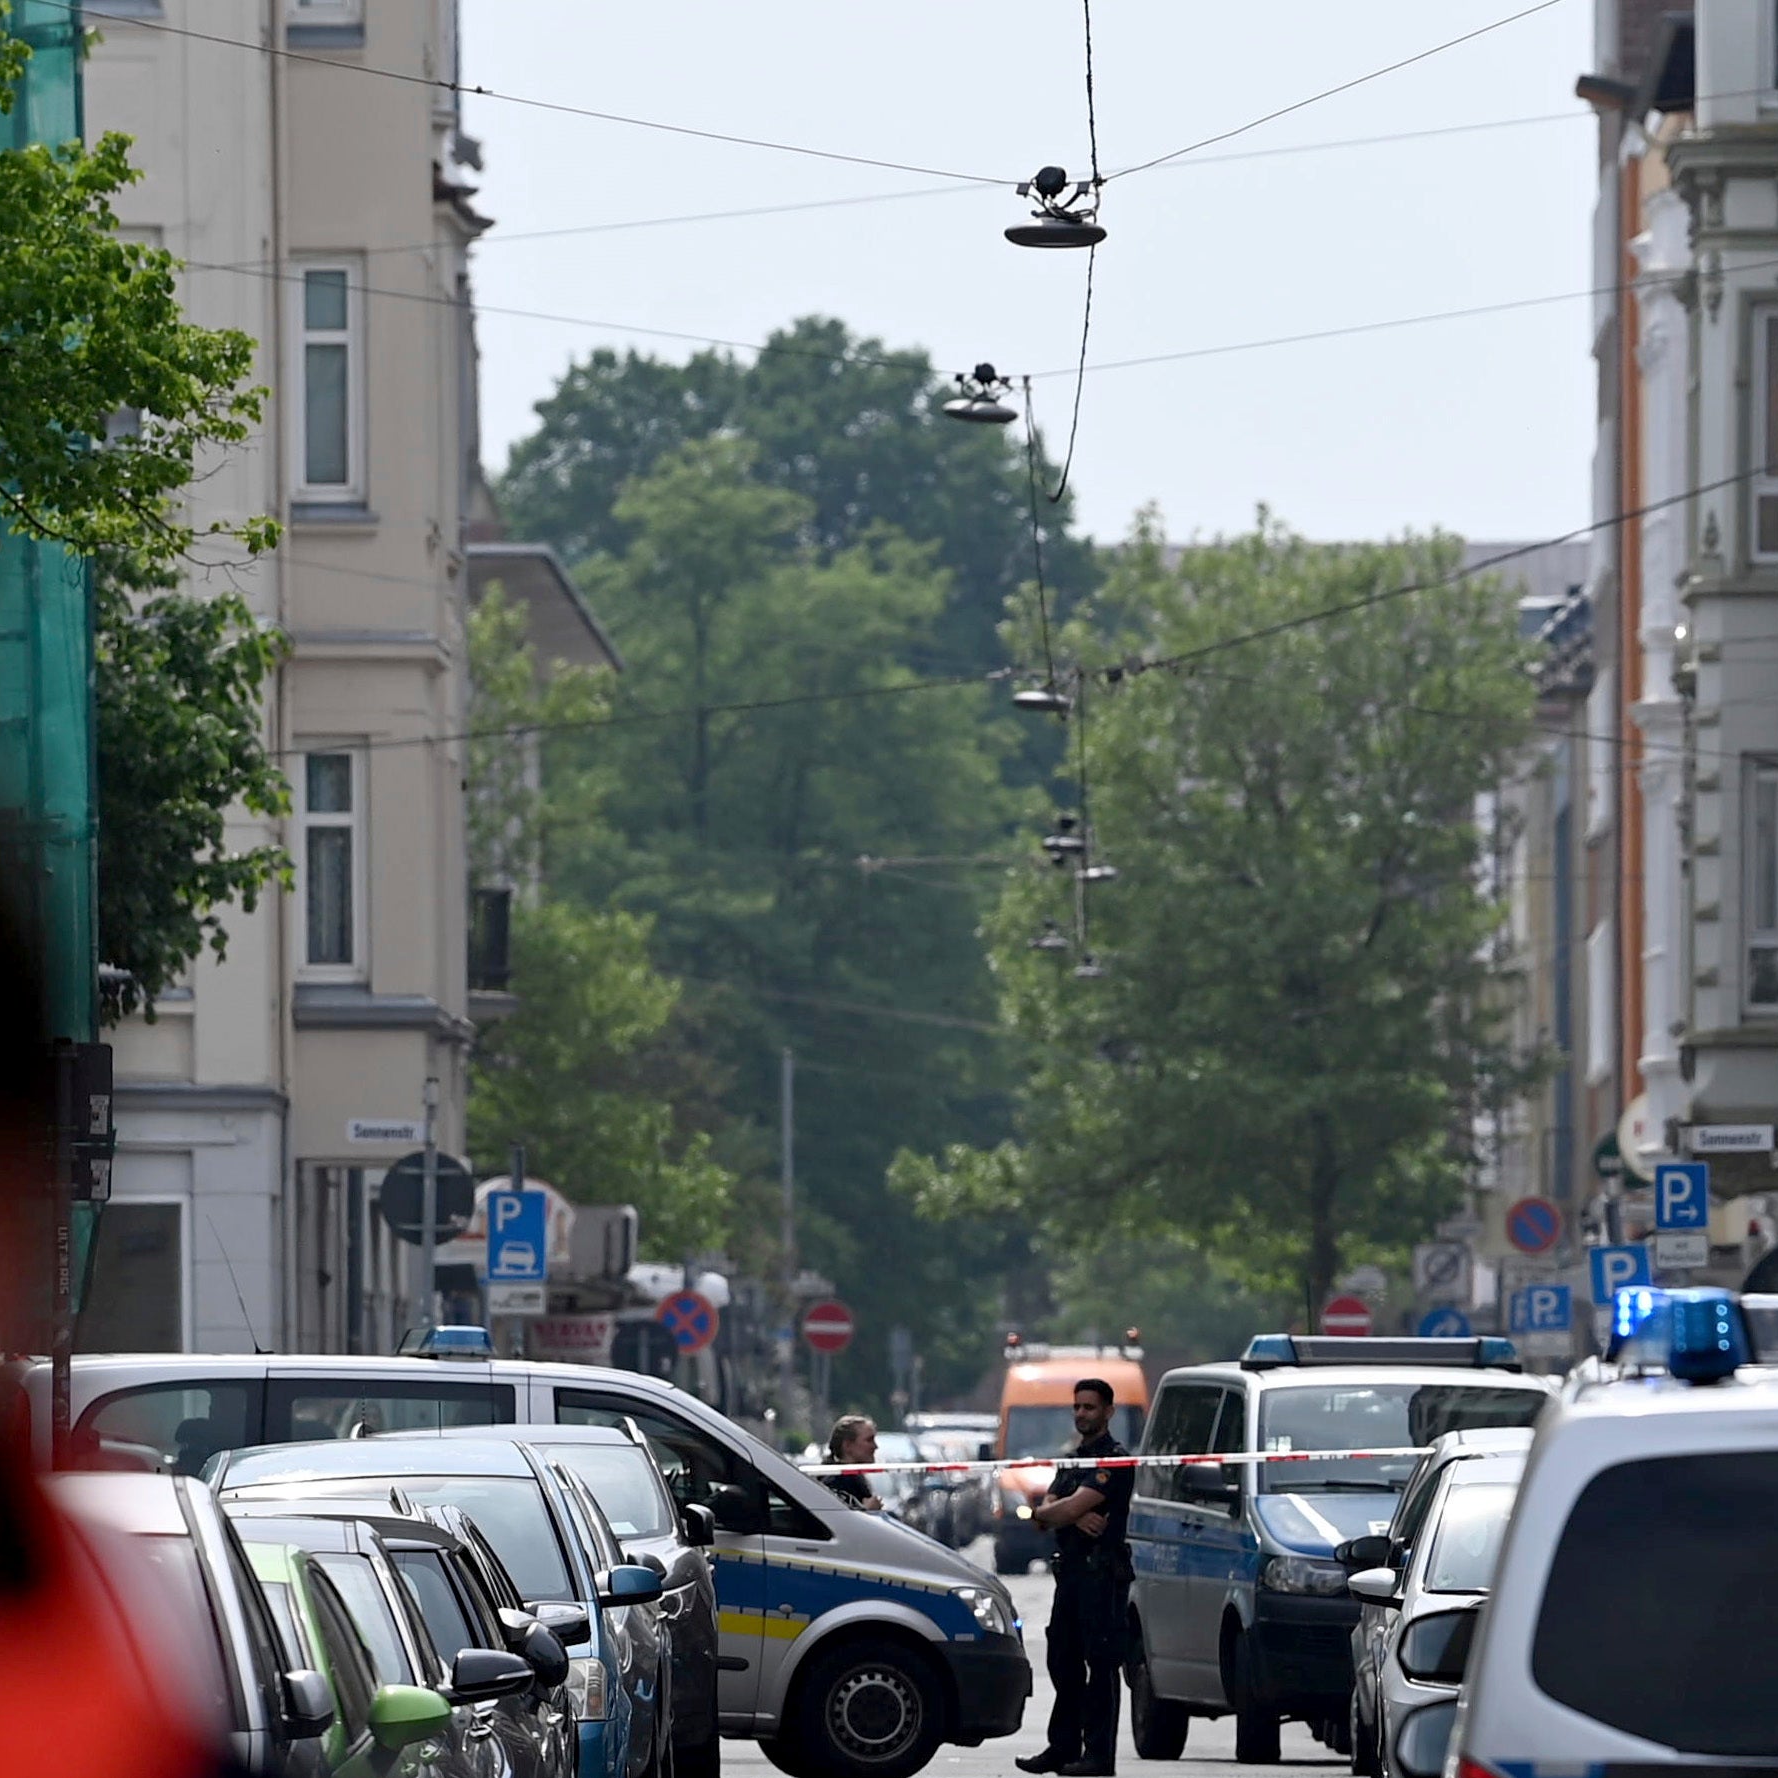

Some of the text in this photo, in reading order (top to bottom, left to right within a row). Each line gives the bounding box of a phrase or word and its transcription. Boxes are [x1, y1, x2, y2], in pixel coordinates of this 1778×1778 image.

[495, 1195, 522, 1232] P
[1662, 1170, 1693, 1223] P
[1602, 1252, 1638, 1299] P
[1530, 1290, 1557, 1328] P
